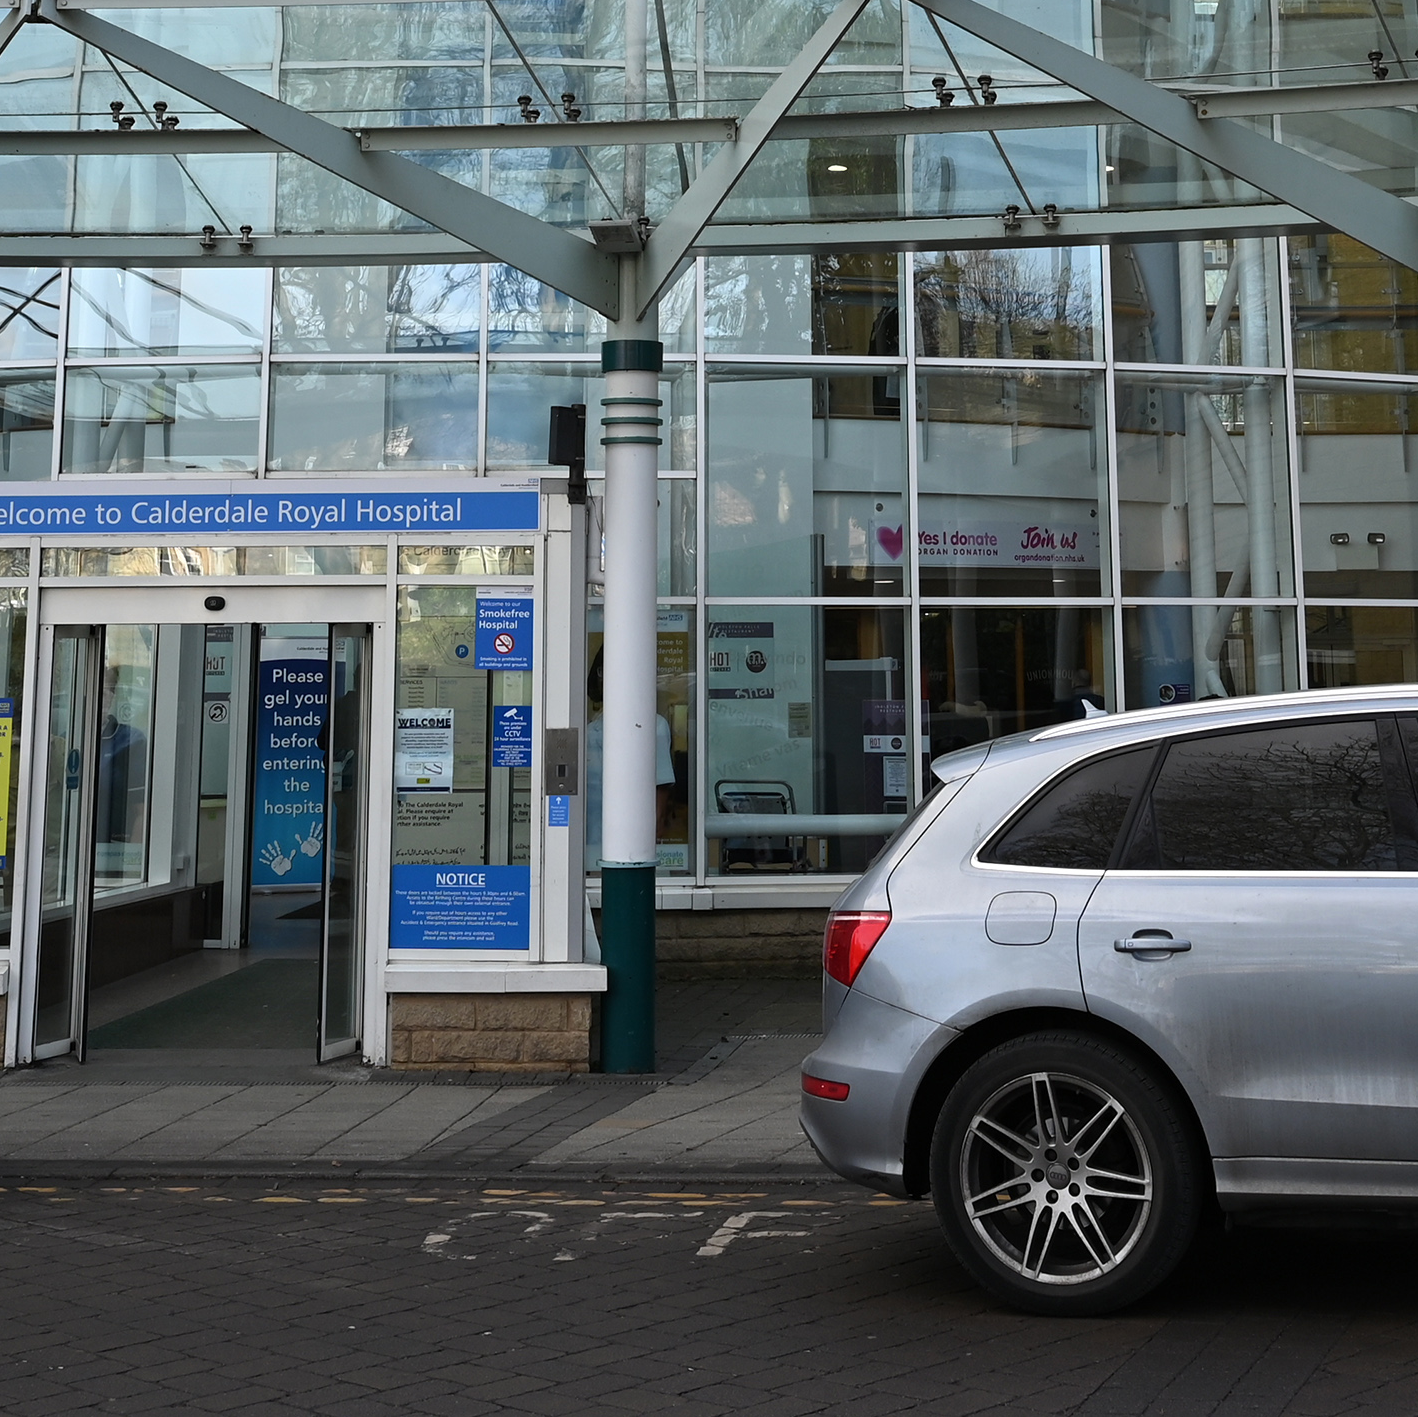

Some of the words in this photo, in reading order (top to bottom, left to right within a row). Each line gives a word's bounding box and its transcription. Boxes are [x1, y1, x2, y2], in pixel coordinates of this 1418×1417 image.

[95, 505, 122, 525] to
[131, 499, 269, 524] Calderdale
[278, 498, 346, 528] Royal
[356, 497, 462, 527] Hospital
[918, 531, 939, 546] Yes
[943, 531, 947, 545] I
[950, 530, 998, 546] donate
[1021, 526, 1057, 549] Join
[1060, 531, 1078, 549] us
[953, 548, 998, 556] DONATION
[1014, 554, 1085, 563] organdonation.nhs.uk
[479, 609, 530, 618] Smokefree
[479, 620, 518, 630] Hospital
[272, 668, 324, 683] Please
[264, 690, 290, 709] gel
[273, 711, 321, 726] hands
[398, 718, 451, 727] WELCOME
[284, 777, 310, 792] the
[264, 799, 324, 818] hospita
[436, 873, 486, 885] NOTICE
